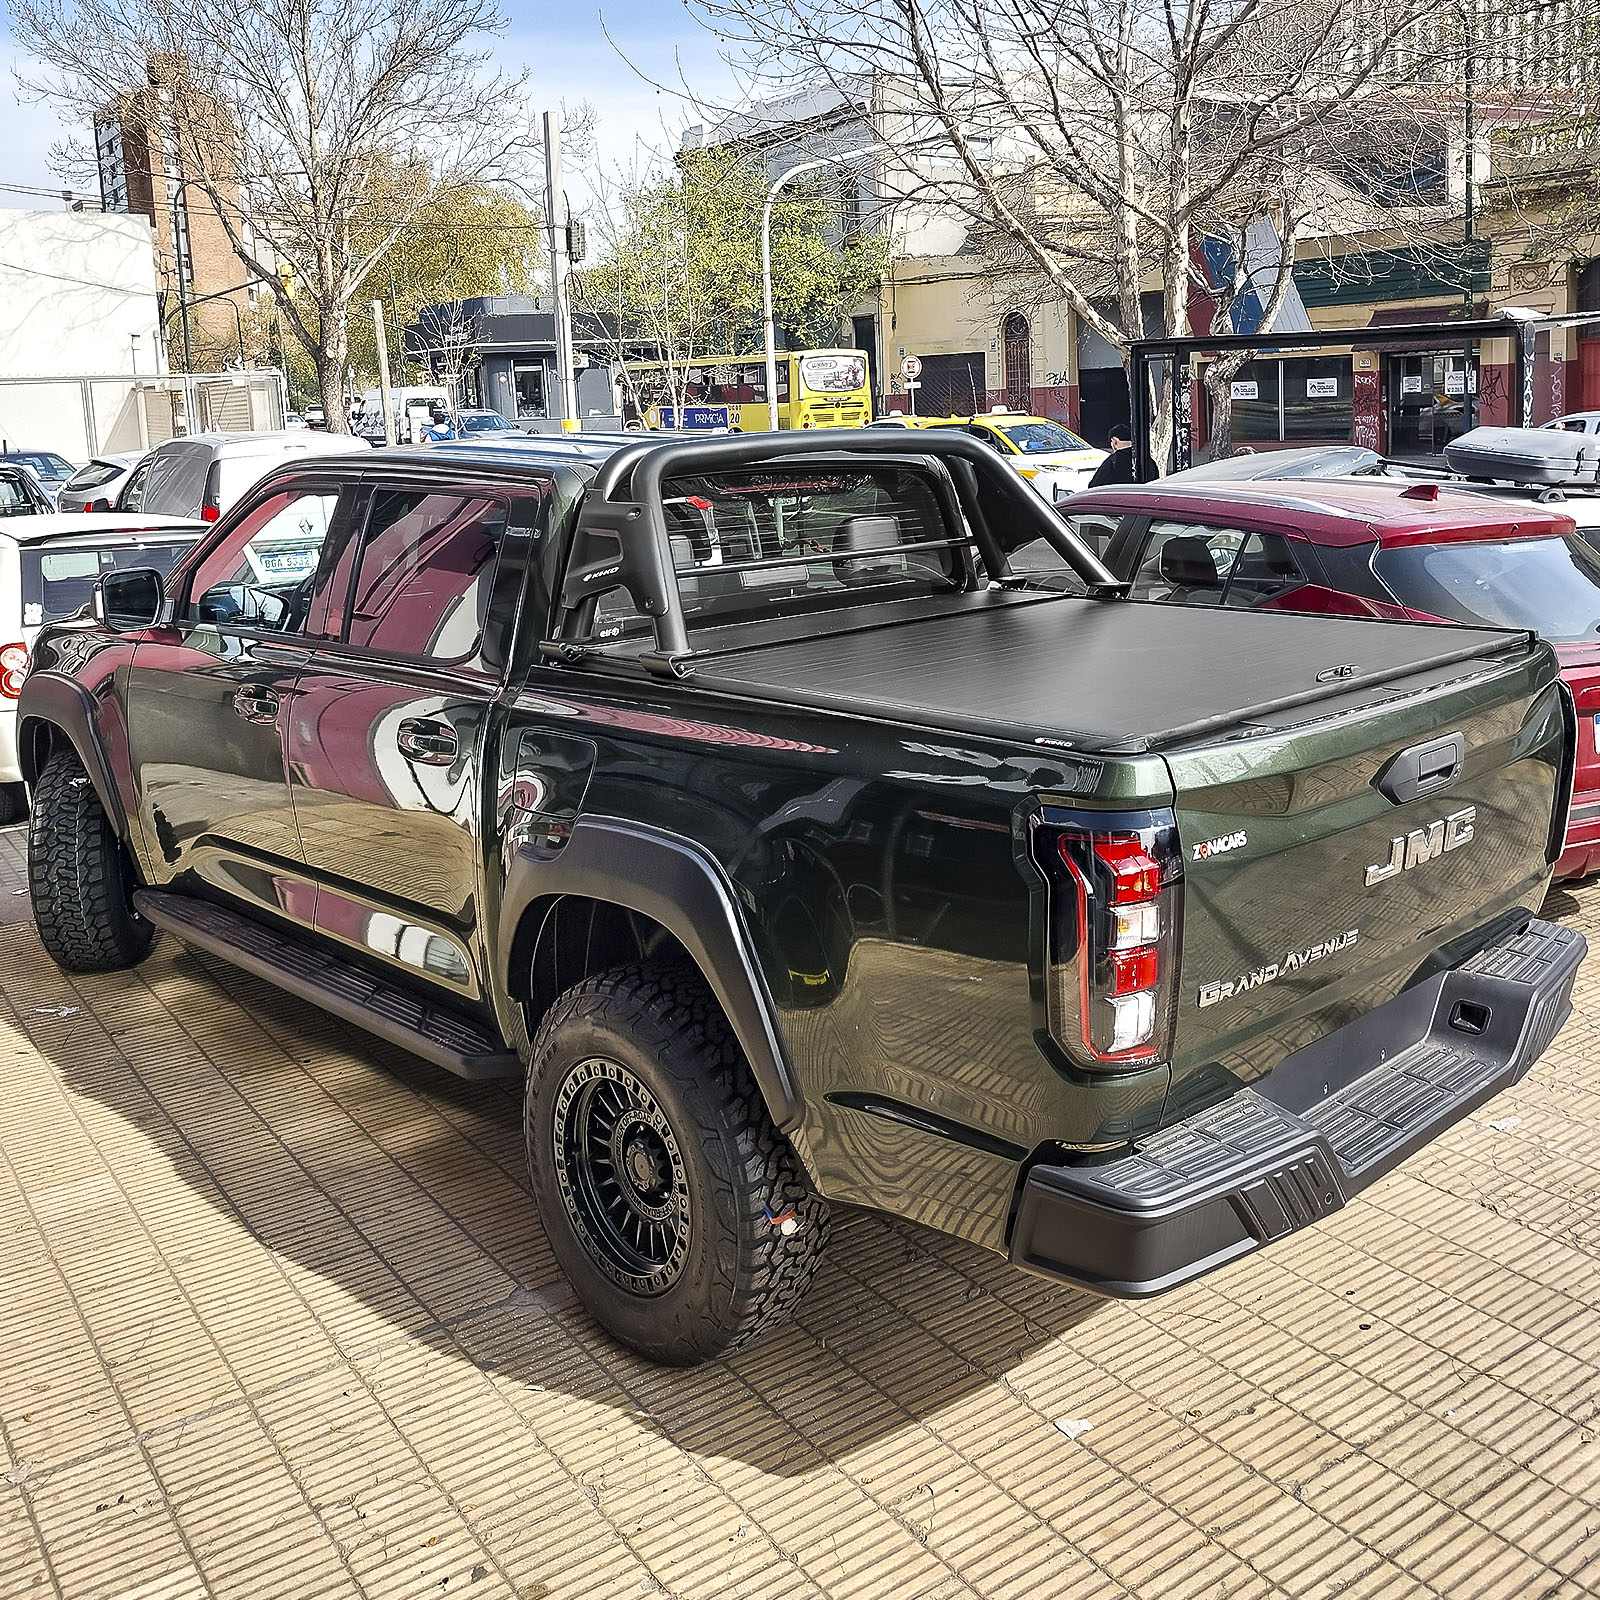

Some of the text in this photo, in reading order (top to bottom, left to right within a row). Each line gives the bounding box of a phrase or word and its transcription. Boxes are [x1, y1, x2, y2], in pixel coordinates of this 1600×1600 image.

[730, 413, 740, 423] 20
[1364, 805, 1477, 887] JMC
[1198, 928, 1360, 1008] GRAND AVENUE
